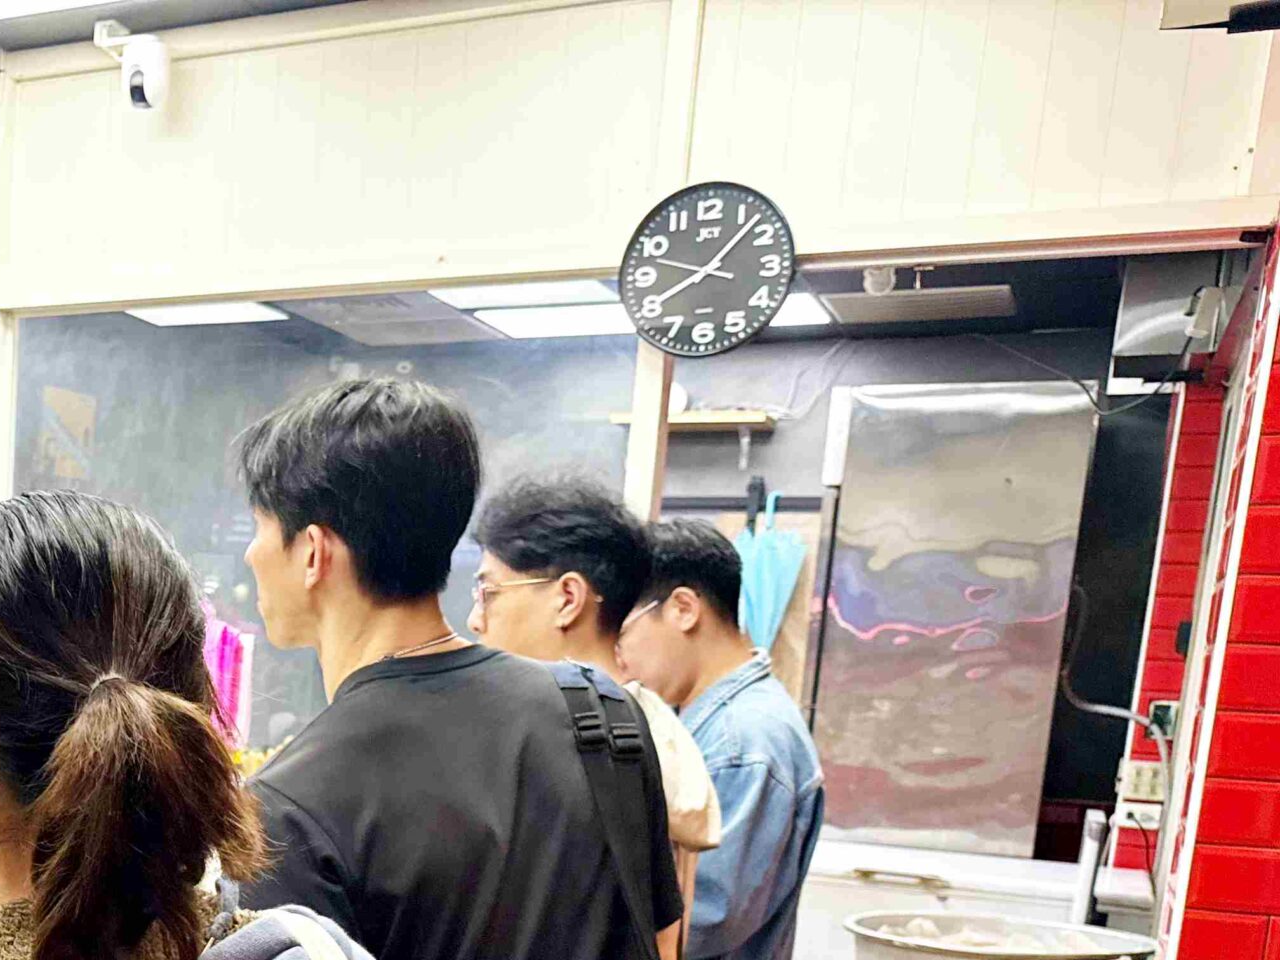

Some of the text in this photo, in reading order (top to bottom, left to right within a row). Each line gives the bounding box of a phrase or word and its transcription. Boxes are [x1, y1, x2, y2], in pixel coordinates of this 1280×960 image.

[696, 197, 723, 221] 12
[737, 203, 746, 225] 1
[668, 210, 688, 232] 11
[638, 234, 669, 257] 10
[752, 223, 775, 246] 2
[634, 265, 657, 288] 9
[758, 253, 781, 277] 3
[640, 294, 663, 318] 8
[747, 284, 771, 308] 4
[662, 314, 684, 338] 7
[691, 321, 715, 344] 6
[723, 310, 746, 333] 5
